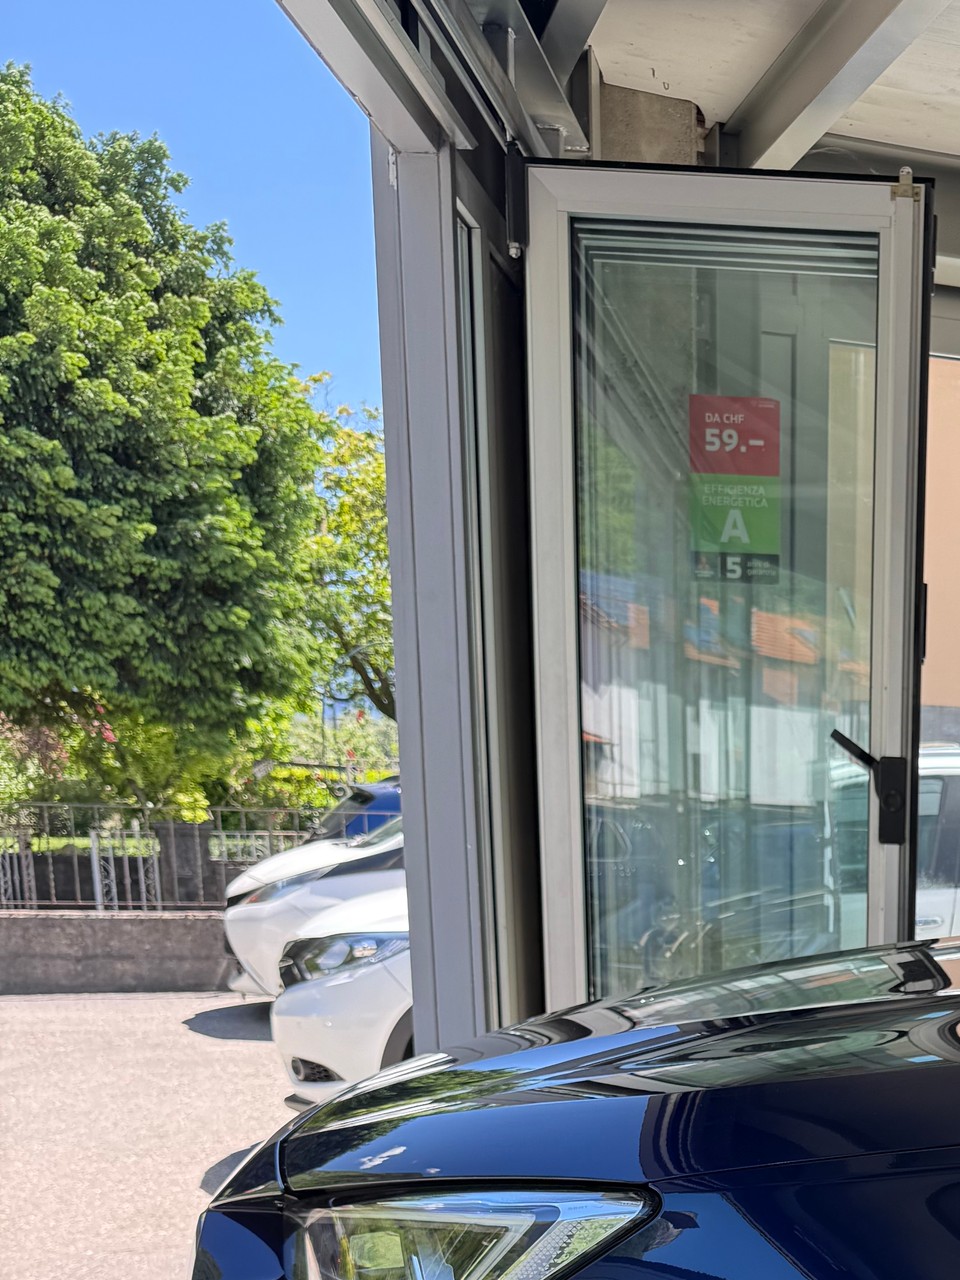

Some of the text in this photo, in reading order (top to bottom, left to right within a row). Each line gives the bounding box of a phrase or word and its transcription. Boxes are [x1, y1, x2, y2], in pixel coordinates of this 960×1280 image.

[705, 413, 745, 424] DA CHF
[704, 484, 765, 495] EFFICIENZA
[702, 496, 768, 508] ENERGETICA
[720, 509, 750, 544] A
[726, 556, 742, 579] 5
